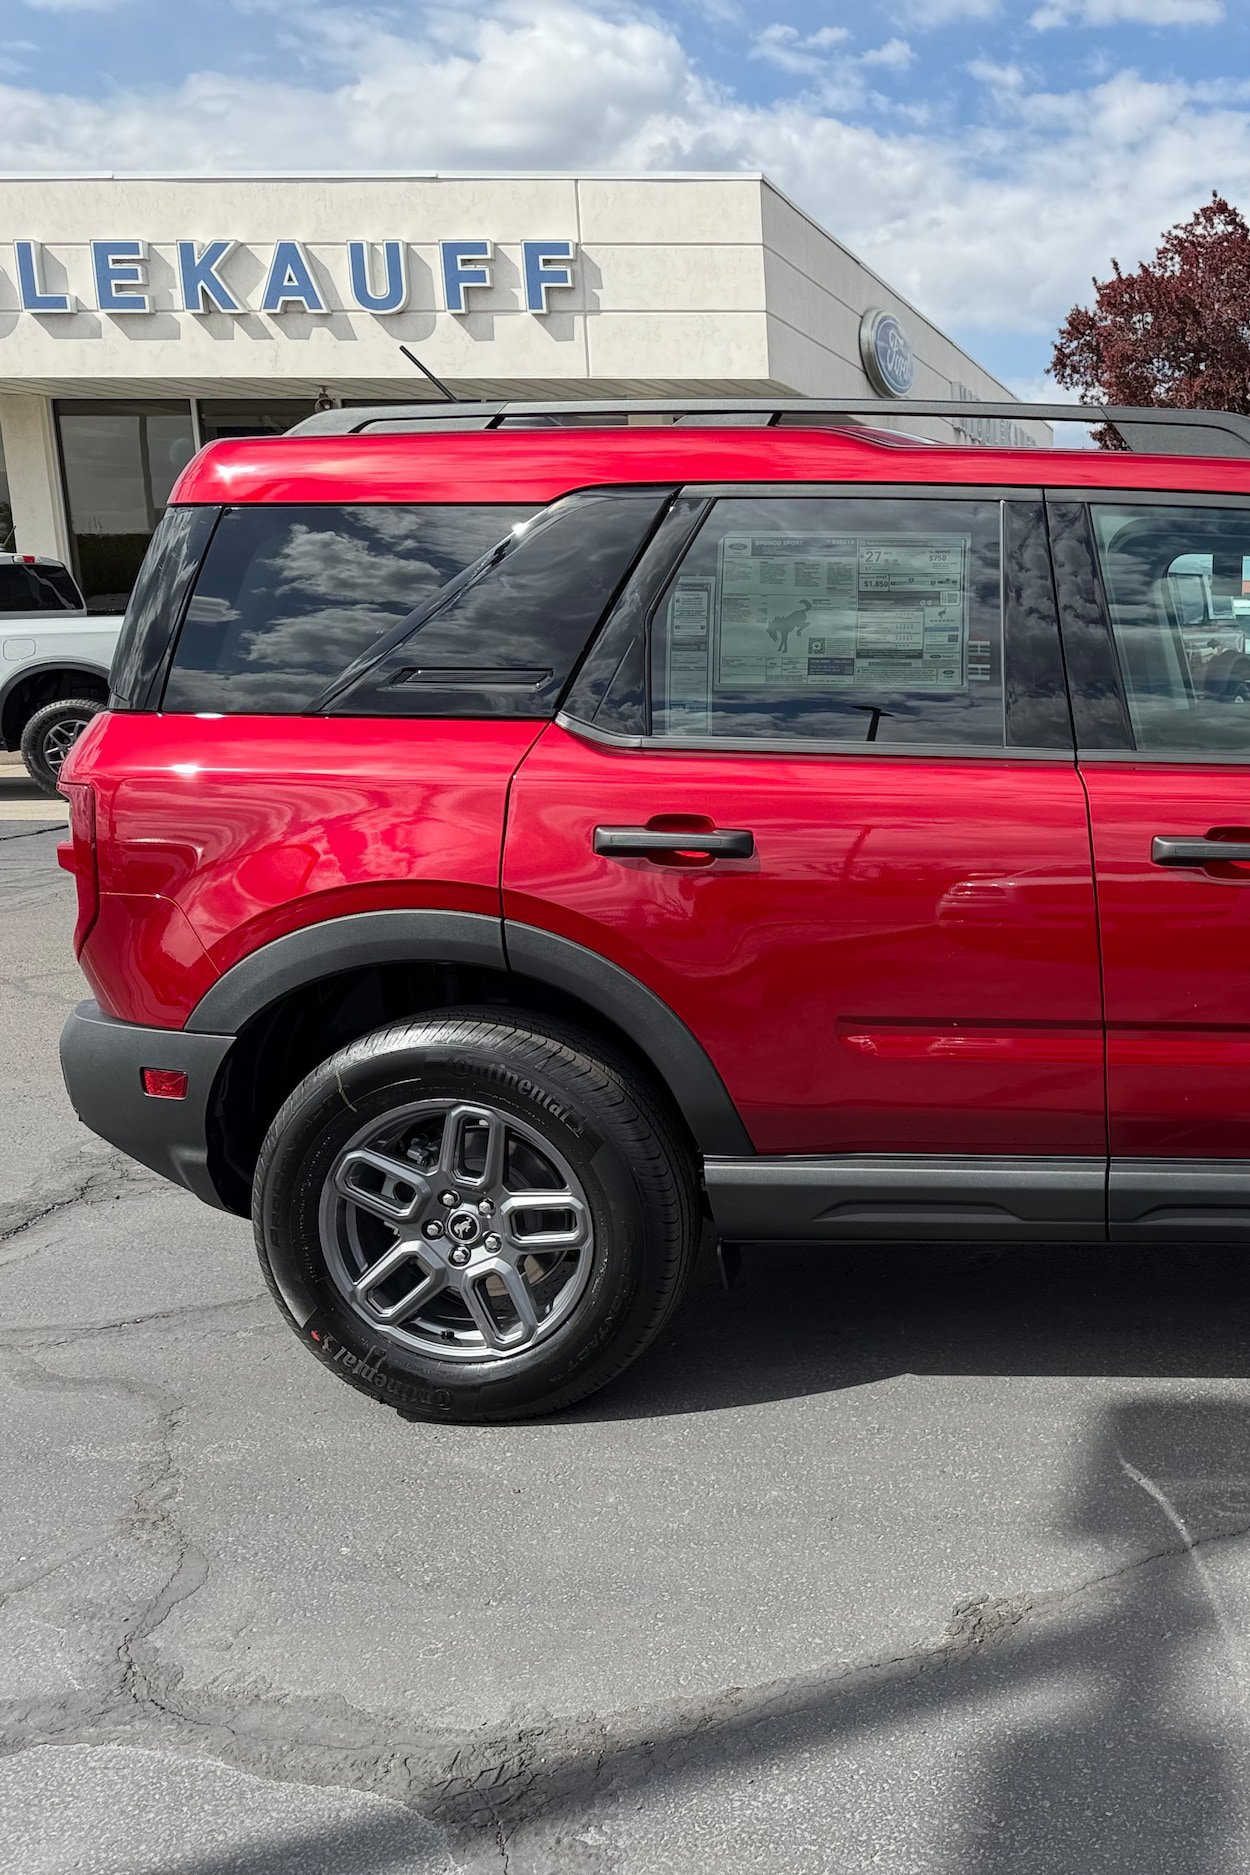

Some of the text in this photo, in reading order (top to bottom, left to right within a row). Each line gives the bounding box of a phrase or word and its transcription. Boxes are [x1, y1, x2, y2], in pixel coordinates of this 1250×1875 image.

[13, 239, 577, 314] LEKAUFF
[886, 328, 912, 383] Ford
[865, 551, 882, 562] 27
